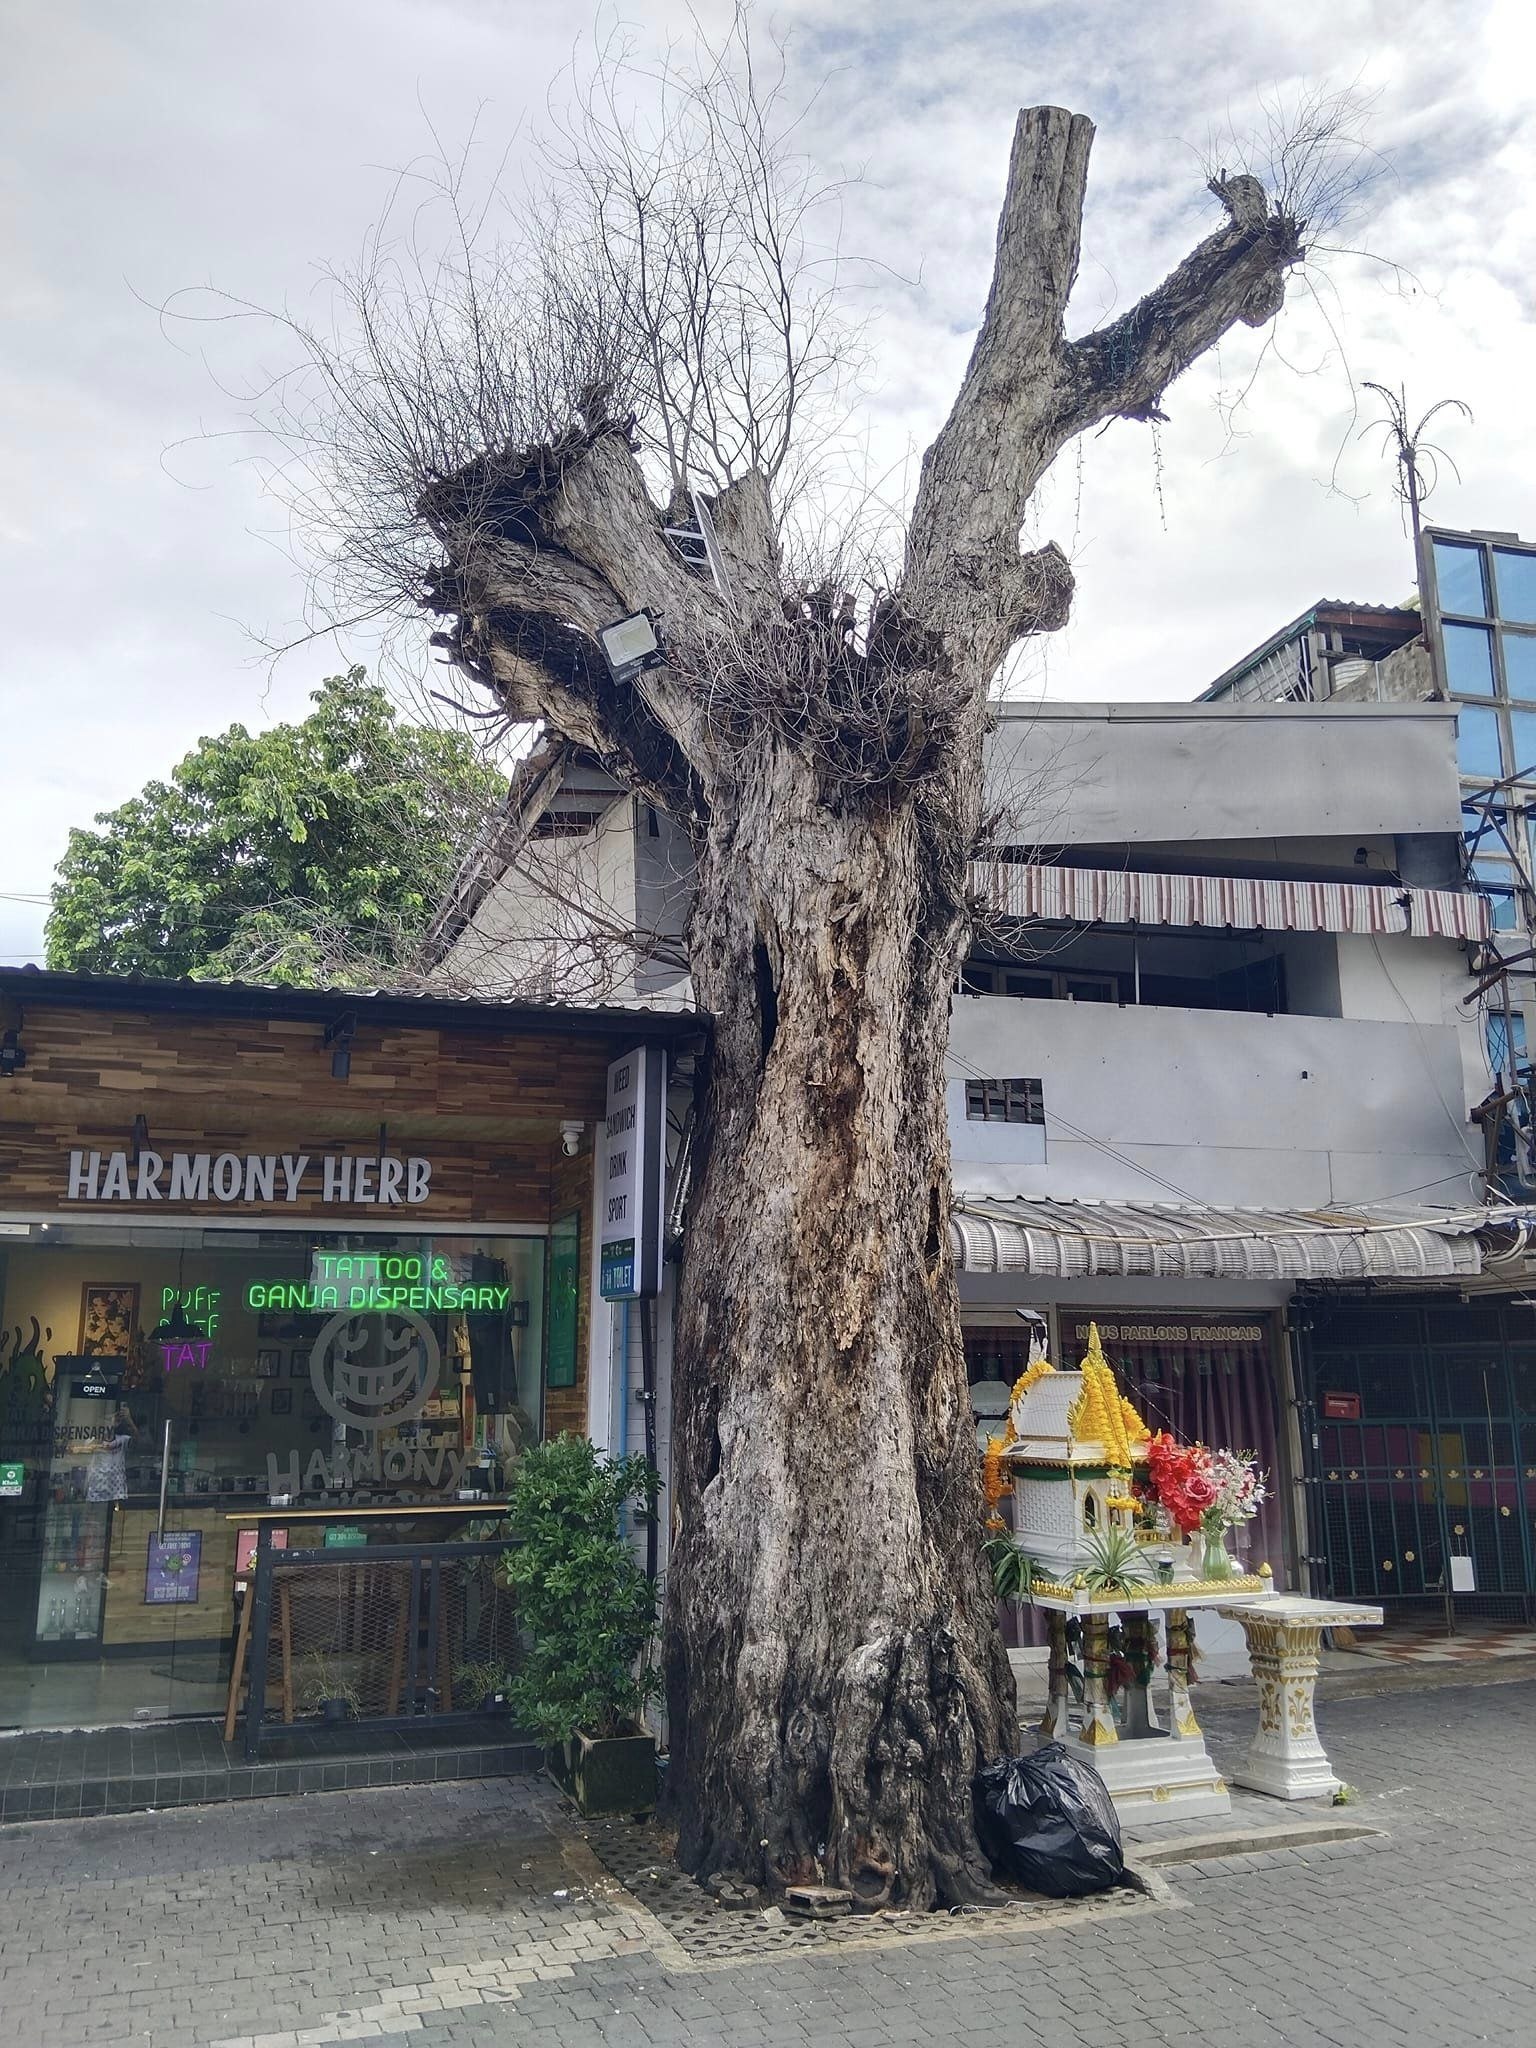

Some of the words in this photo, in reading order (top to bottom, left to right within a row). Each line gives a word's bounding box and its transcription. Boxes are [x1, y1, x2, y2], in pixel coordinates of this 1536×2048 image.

[613, 1065, 630, 1094] WEED
[606, 1104, 635, 1138] SANDWICH
[66, 1151, 310, 1203] HARMONY
[321, 1156, 433, 1204] HERB
[609, 1150, 628, 1180] DRINK
[607, 1195, 628, 1223] SPORT
[319, 1256, 421, 1280] TATTOO
[431, 1258, 449, 1281] &
[613, 1265, 631, 1288] TOILET
[162, 1286, 221, 1311] PUFF
[248, 1285, 338, 1309] GANJA
[349, 1286, 510, 1310] DISPENSARY
[1076, 1325, 1119, 1340] NUS
[1121, 1326, 1187, 1341] PARLONS
[1190, 1326, 1262, 1341] FRANCAIS
[161, 1343, 214, 1371] TAT
[83, 1385, 106, 1393] OPEN
[266, 1448, 467, 1496] HARMONY
